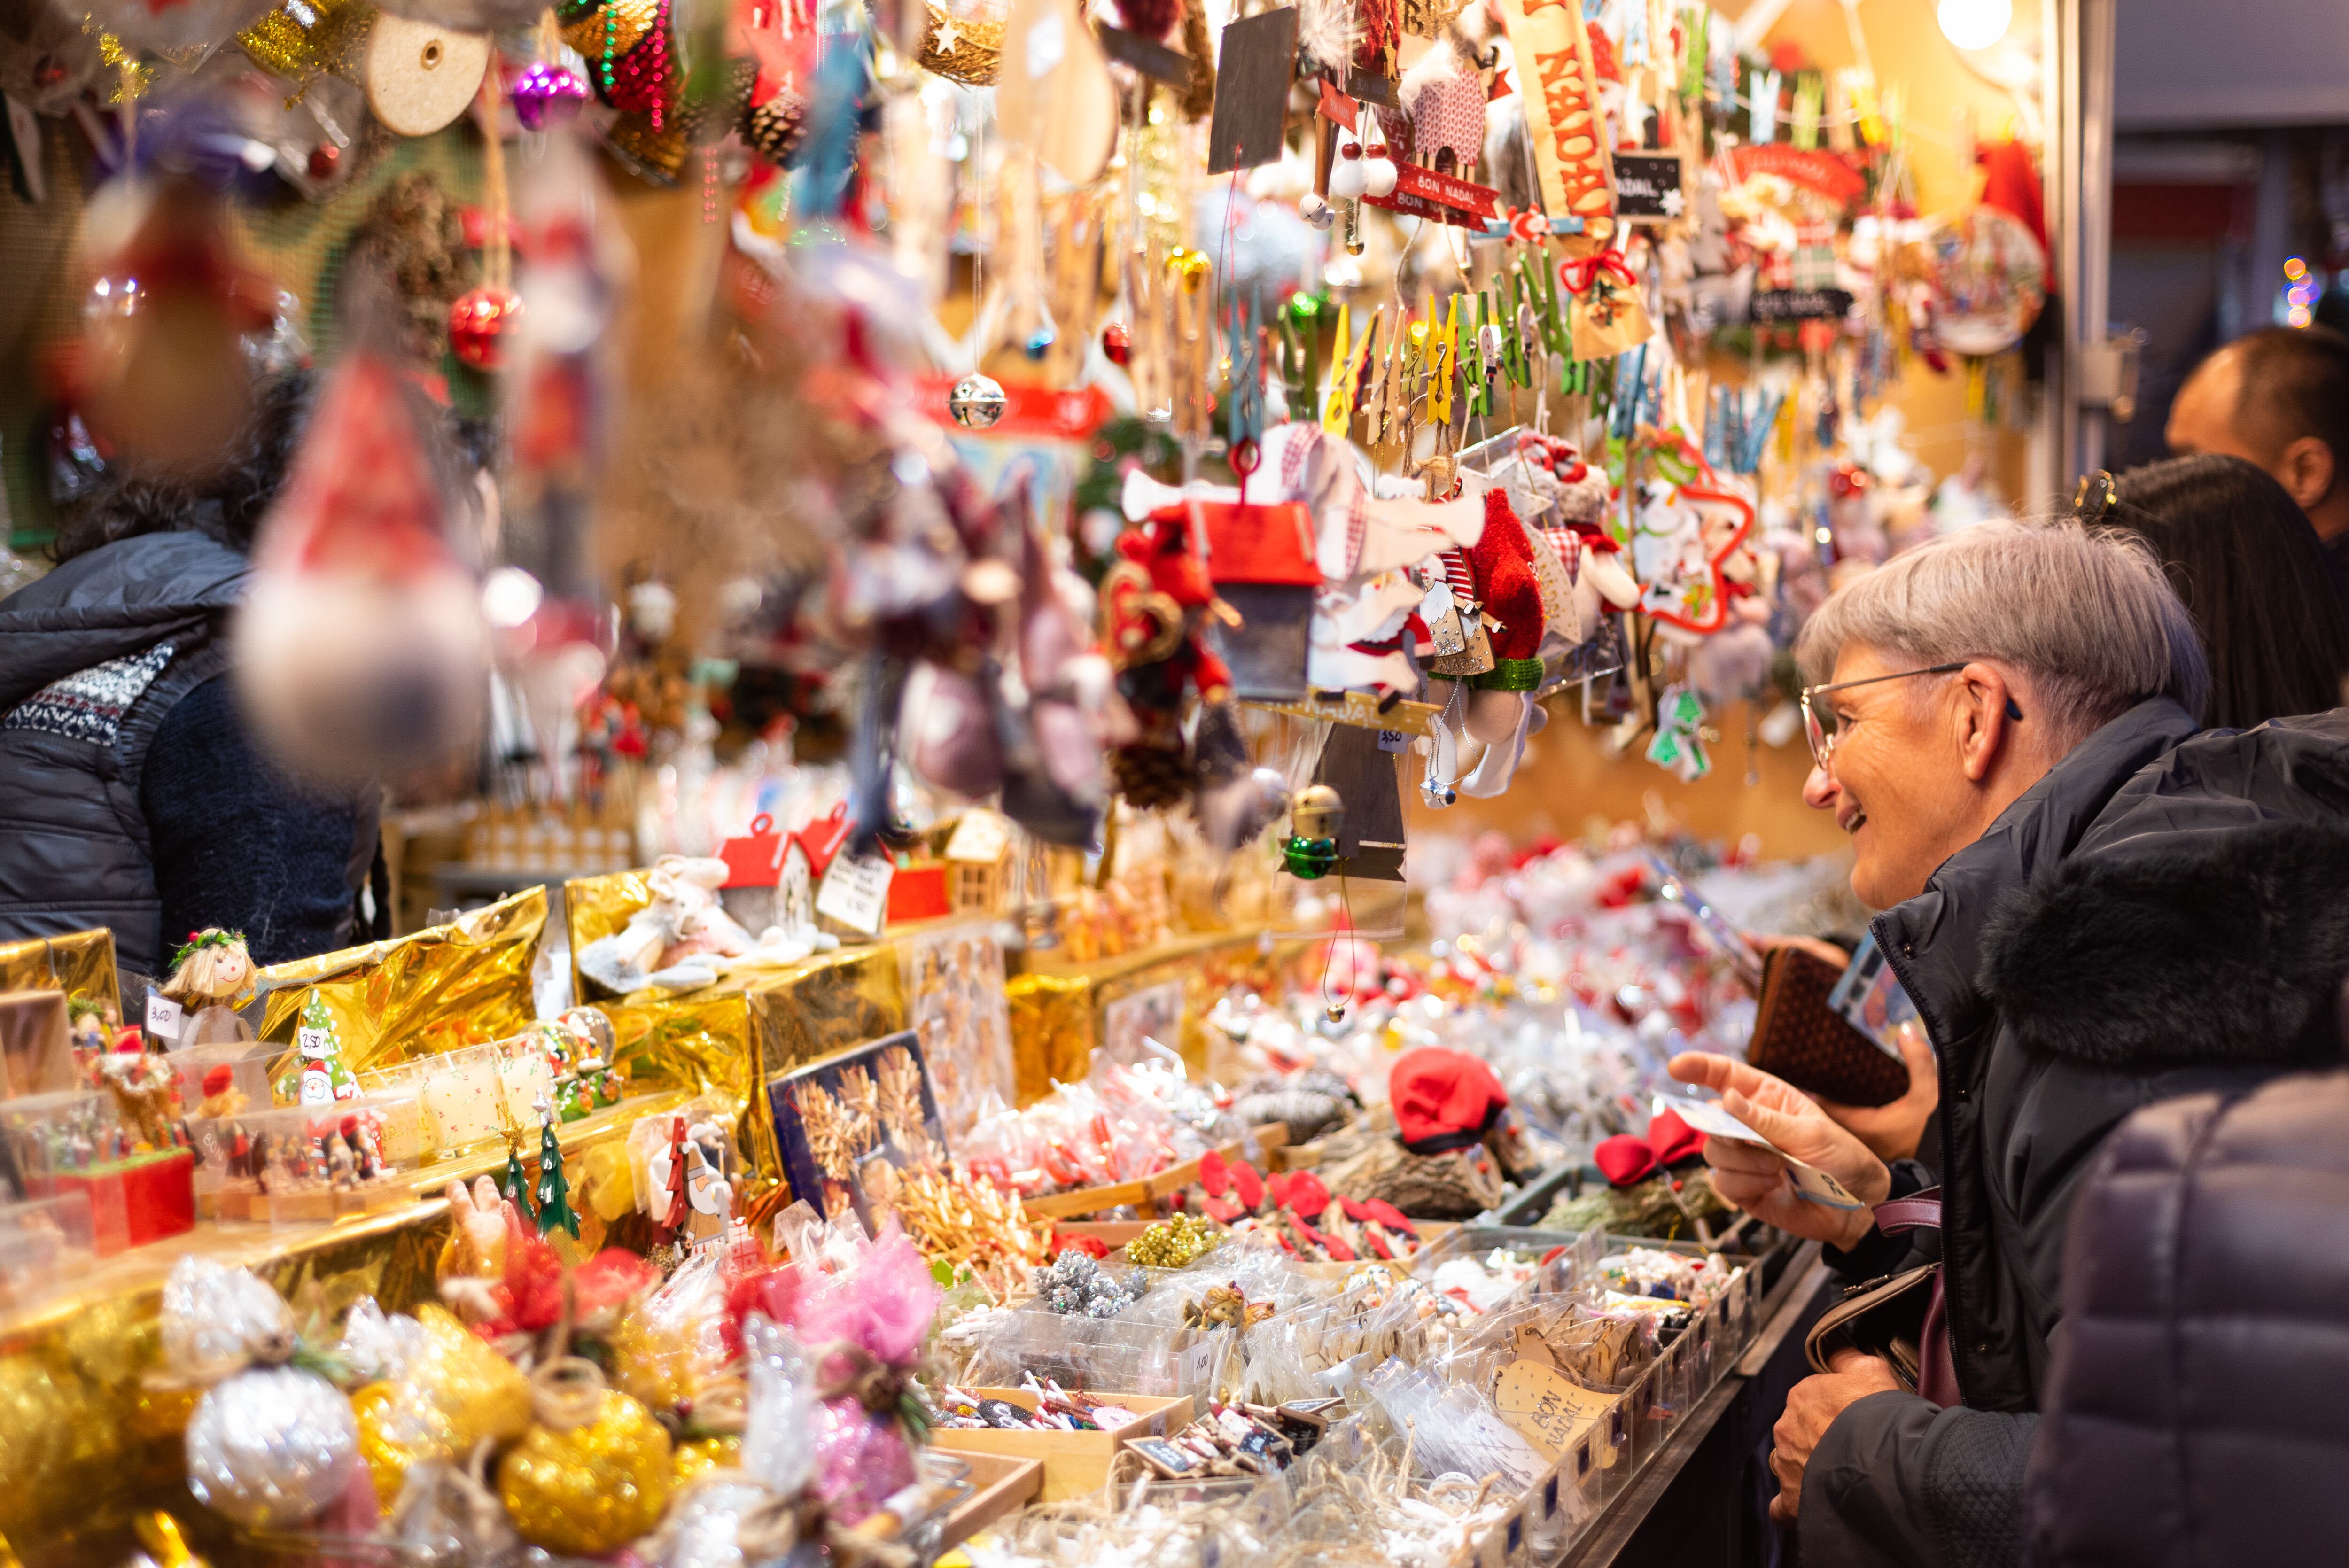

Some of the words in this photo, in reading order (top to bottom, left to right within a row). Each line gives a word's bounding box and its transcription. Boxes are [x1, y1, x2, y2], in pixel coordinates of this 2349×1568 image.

[1397, 192, 1423, 209] BON
[1418, 175, 1439, 194] BON
[1445, 184, 1476, 205] NADAL
[151, 1006, 171, 1023] 3,00
[303, 1034, 321, 1050] 2,50
[203, 1132, 224, 1161] BON
[1196, 1354, 1209, 1371] 1,00
[1530, 1388, 1562, 1430] BON
[1545, 1399, 1584, 1453] NADAL
